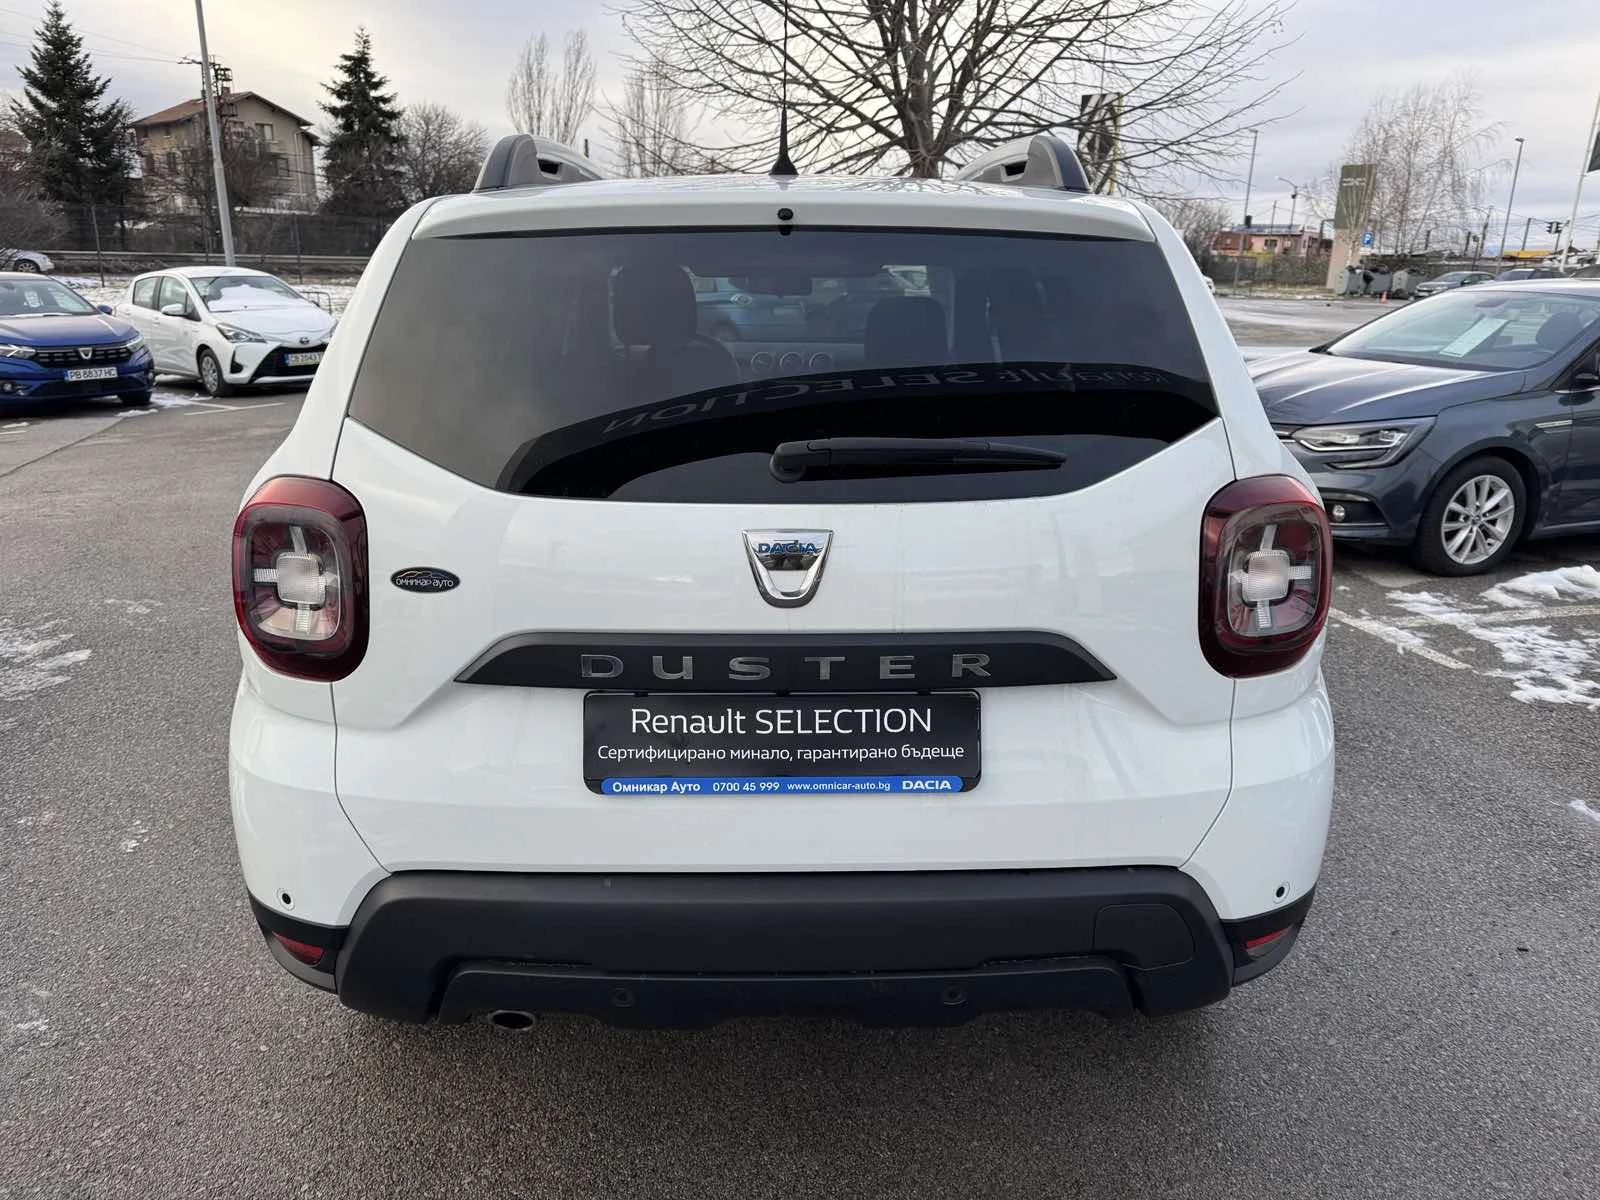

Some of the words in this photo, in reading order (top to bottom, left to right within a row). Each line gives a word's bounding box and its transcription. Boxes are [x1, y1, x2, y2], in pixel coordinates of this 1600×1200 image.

[757, 541, 817, 553] DACIA
[580, 653, 992, 681] DUSTER
[631, 708, 746, 734] Renault
[755, 708, 932, 734] SELECTION
[597, 745, 726, 763] Сертифицирано
[730, 749, 793, 761] минало,
[797, 748, 898, 763] гарантирано
[901, 744, 965, 760] бъдеще
[612, 782, 668, 794] Омникар
[670, 781, 701, 794] Ауто
[712, 782, 741, 792] 0700
[742, 782, 757, 792] 45
[759, 781, 780, 792] 999
[786, 781, 891, 792] www.omnicar-auto.bg
[902, 780, 952, 790] DACIA
